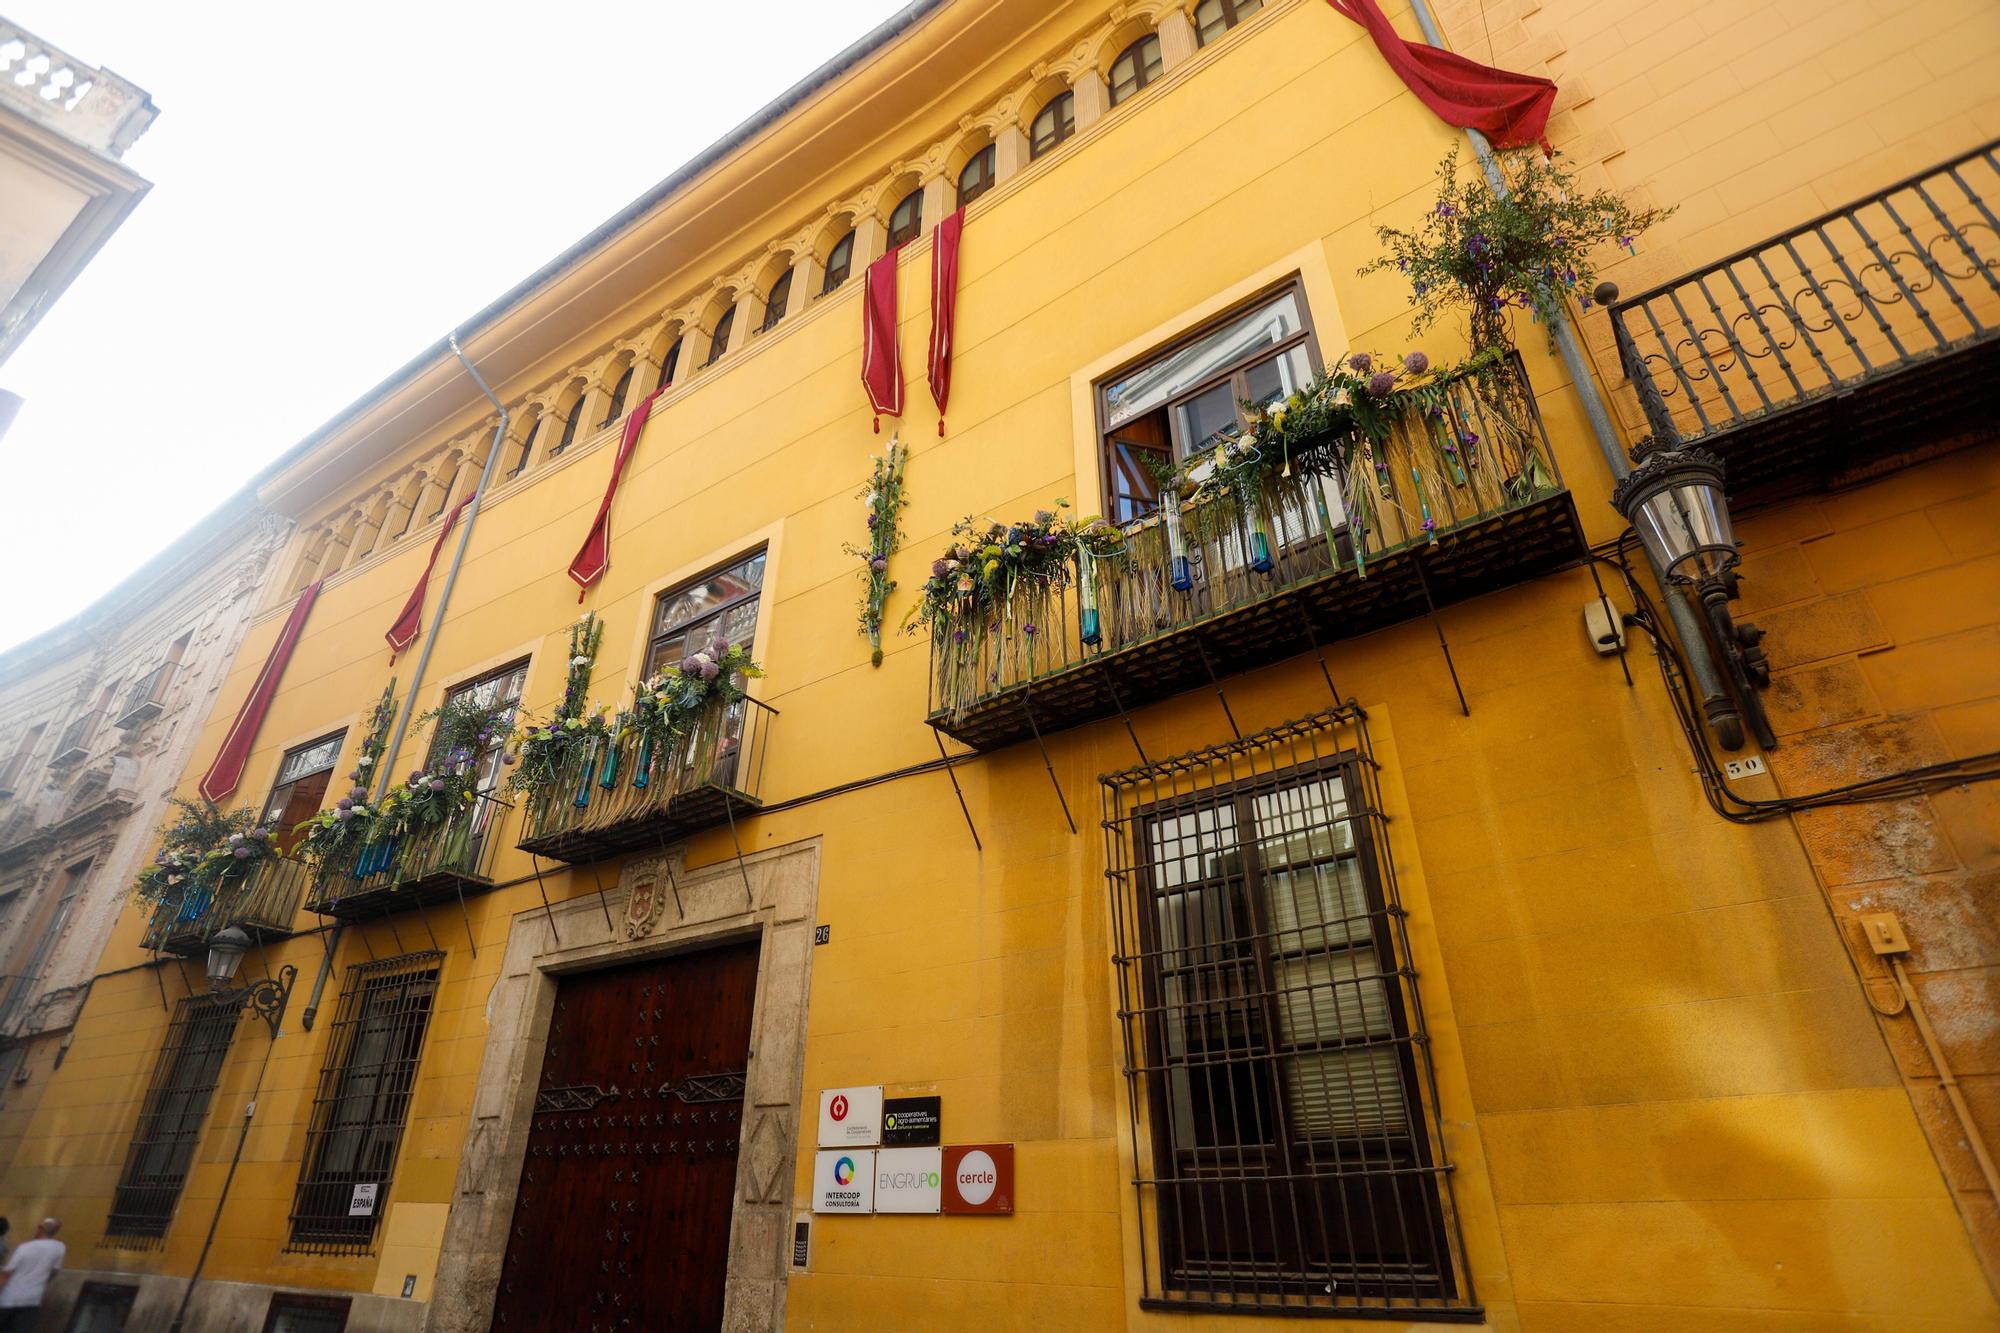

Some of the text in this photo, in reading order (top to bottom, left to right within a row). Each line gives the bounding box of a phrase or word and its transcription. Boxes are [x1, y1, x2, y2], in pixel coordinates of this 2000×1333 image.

[816, 927, 828, 943] 26
[897, 1111, 928, 1119] cooperatives
[959, 1171, 993, 1184] cercle
[352, 1196, 373, 1209] ESPAÑA
[825, 1200, 860, 1208] CONSULTORÍA
